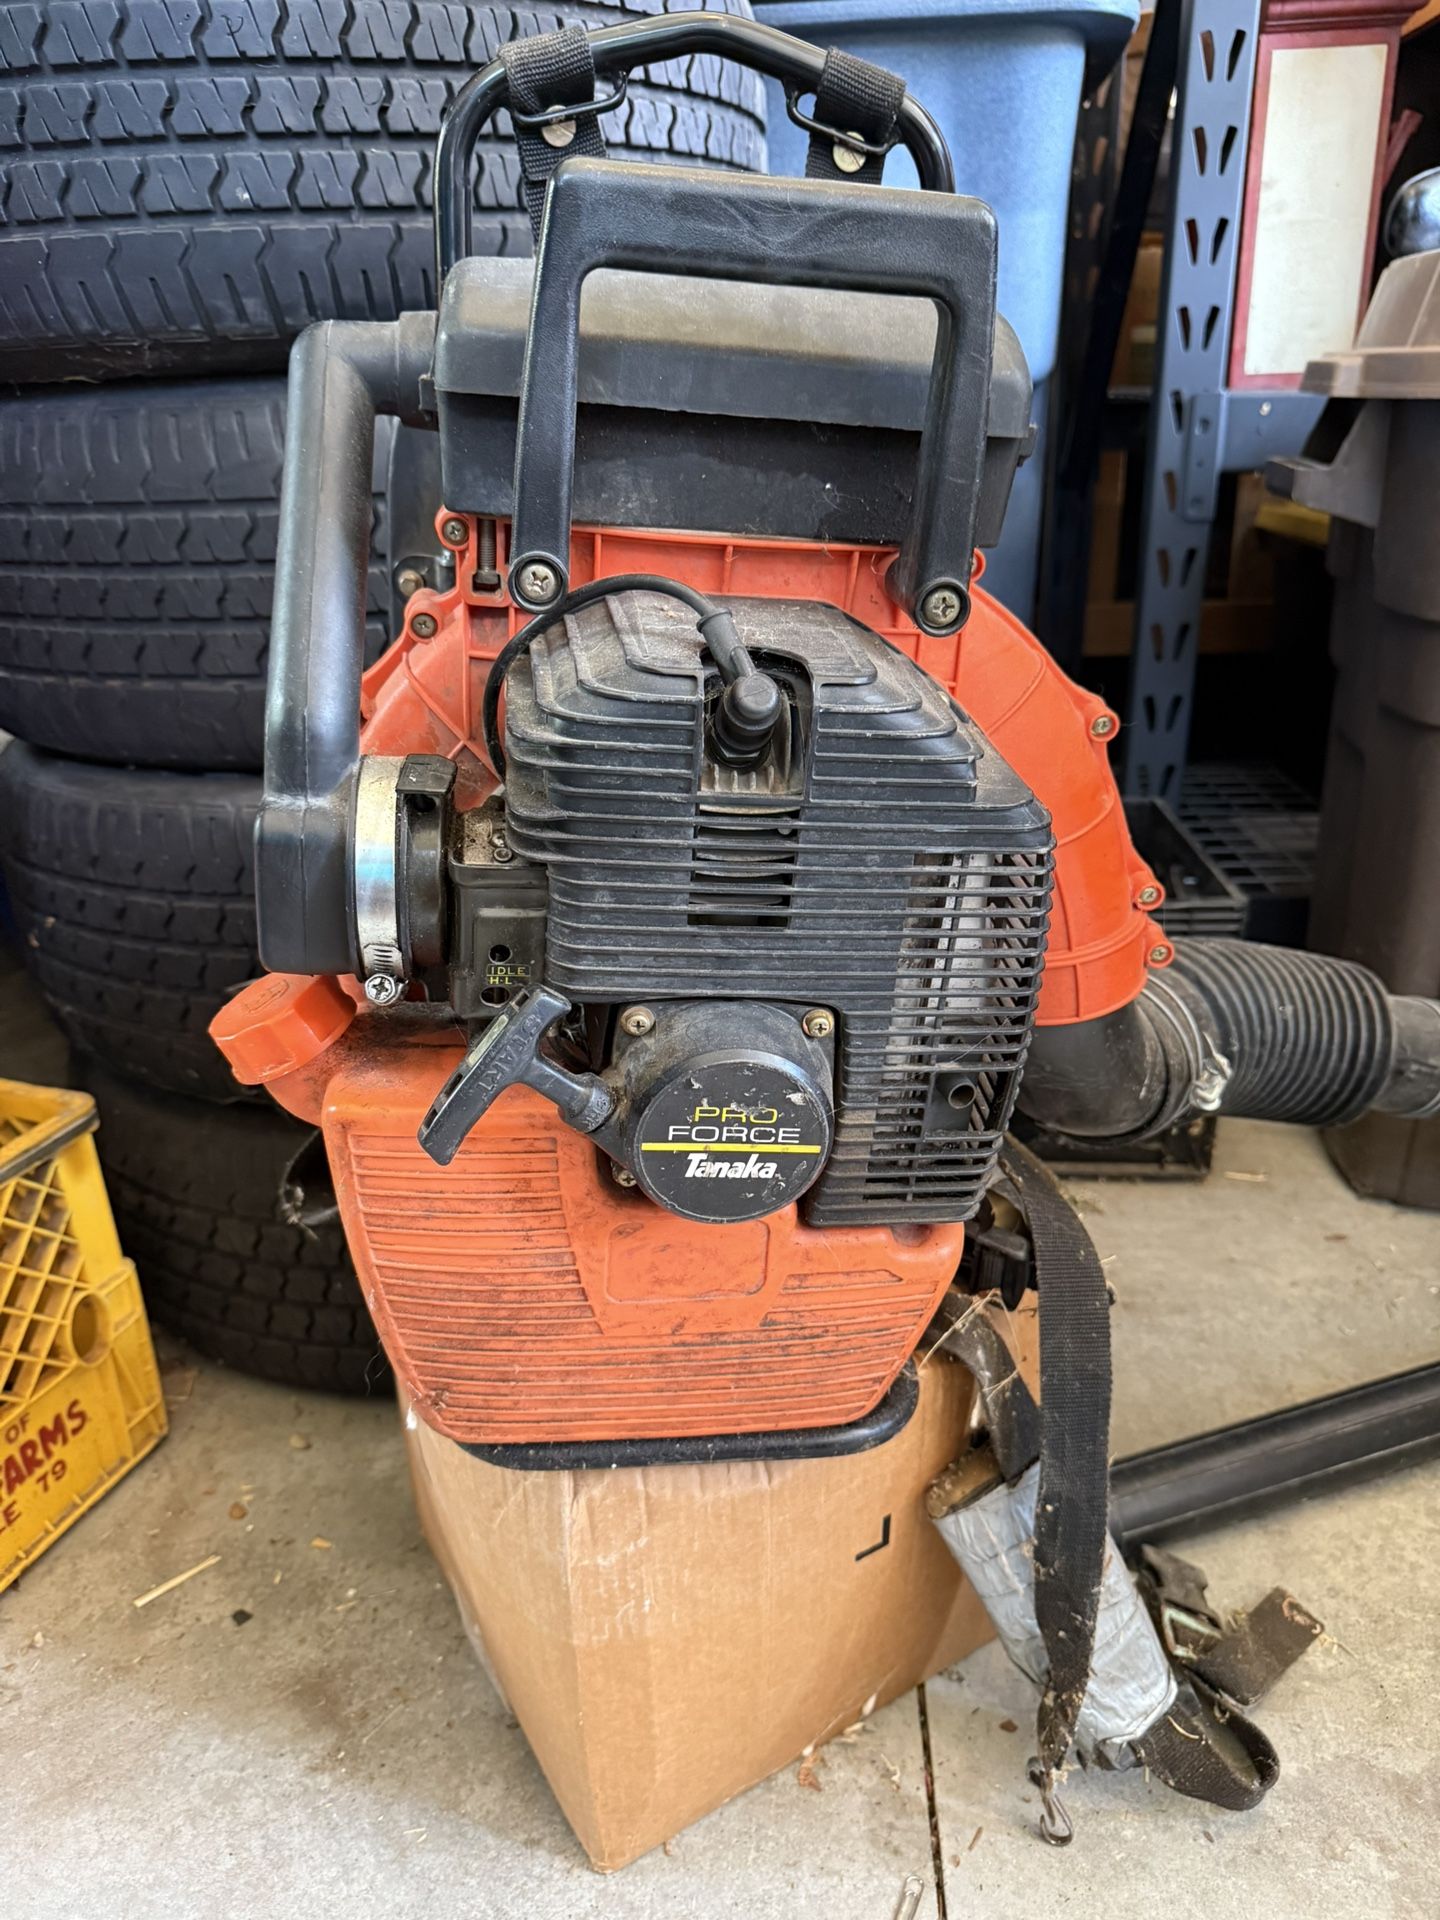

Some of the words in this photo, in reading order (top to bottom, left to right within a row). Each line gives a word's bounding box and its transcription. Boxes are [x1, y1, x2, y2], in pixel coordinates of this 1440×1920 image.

[491, 966, 526, 976] IDLE
[477, 1013, 543, 1101] START
[694, 1106, 778, 1124] PRO
[668, 1125, 801, 1143] FORCE
[685, 1152, 778, 1179] Tanaka
[5, 1412, 30, 1445] OF
[0, 1398, 87, 1503] ARMS
[36, 1458, 67, 1493] 79
